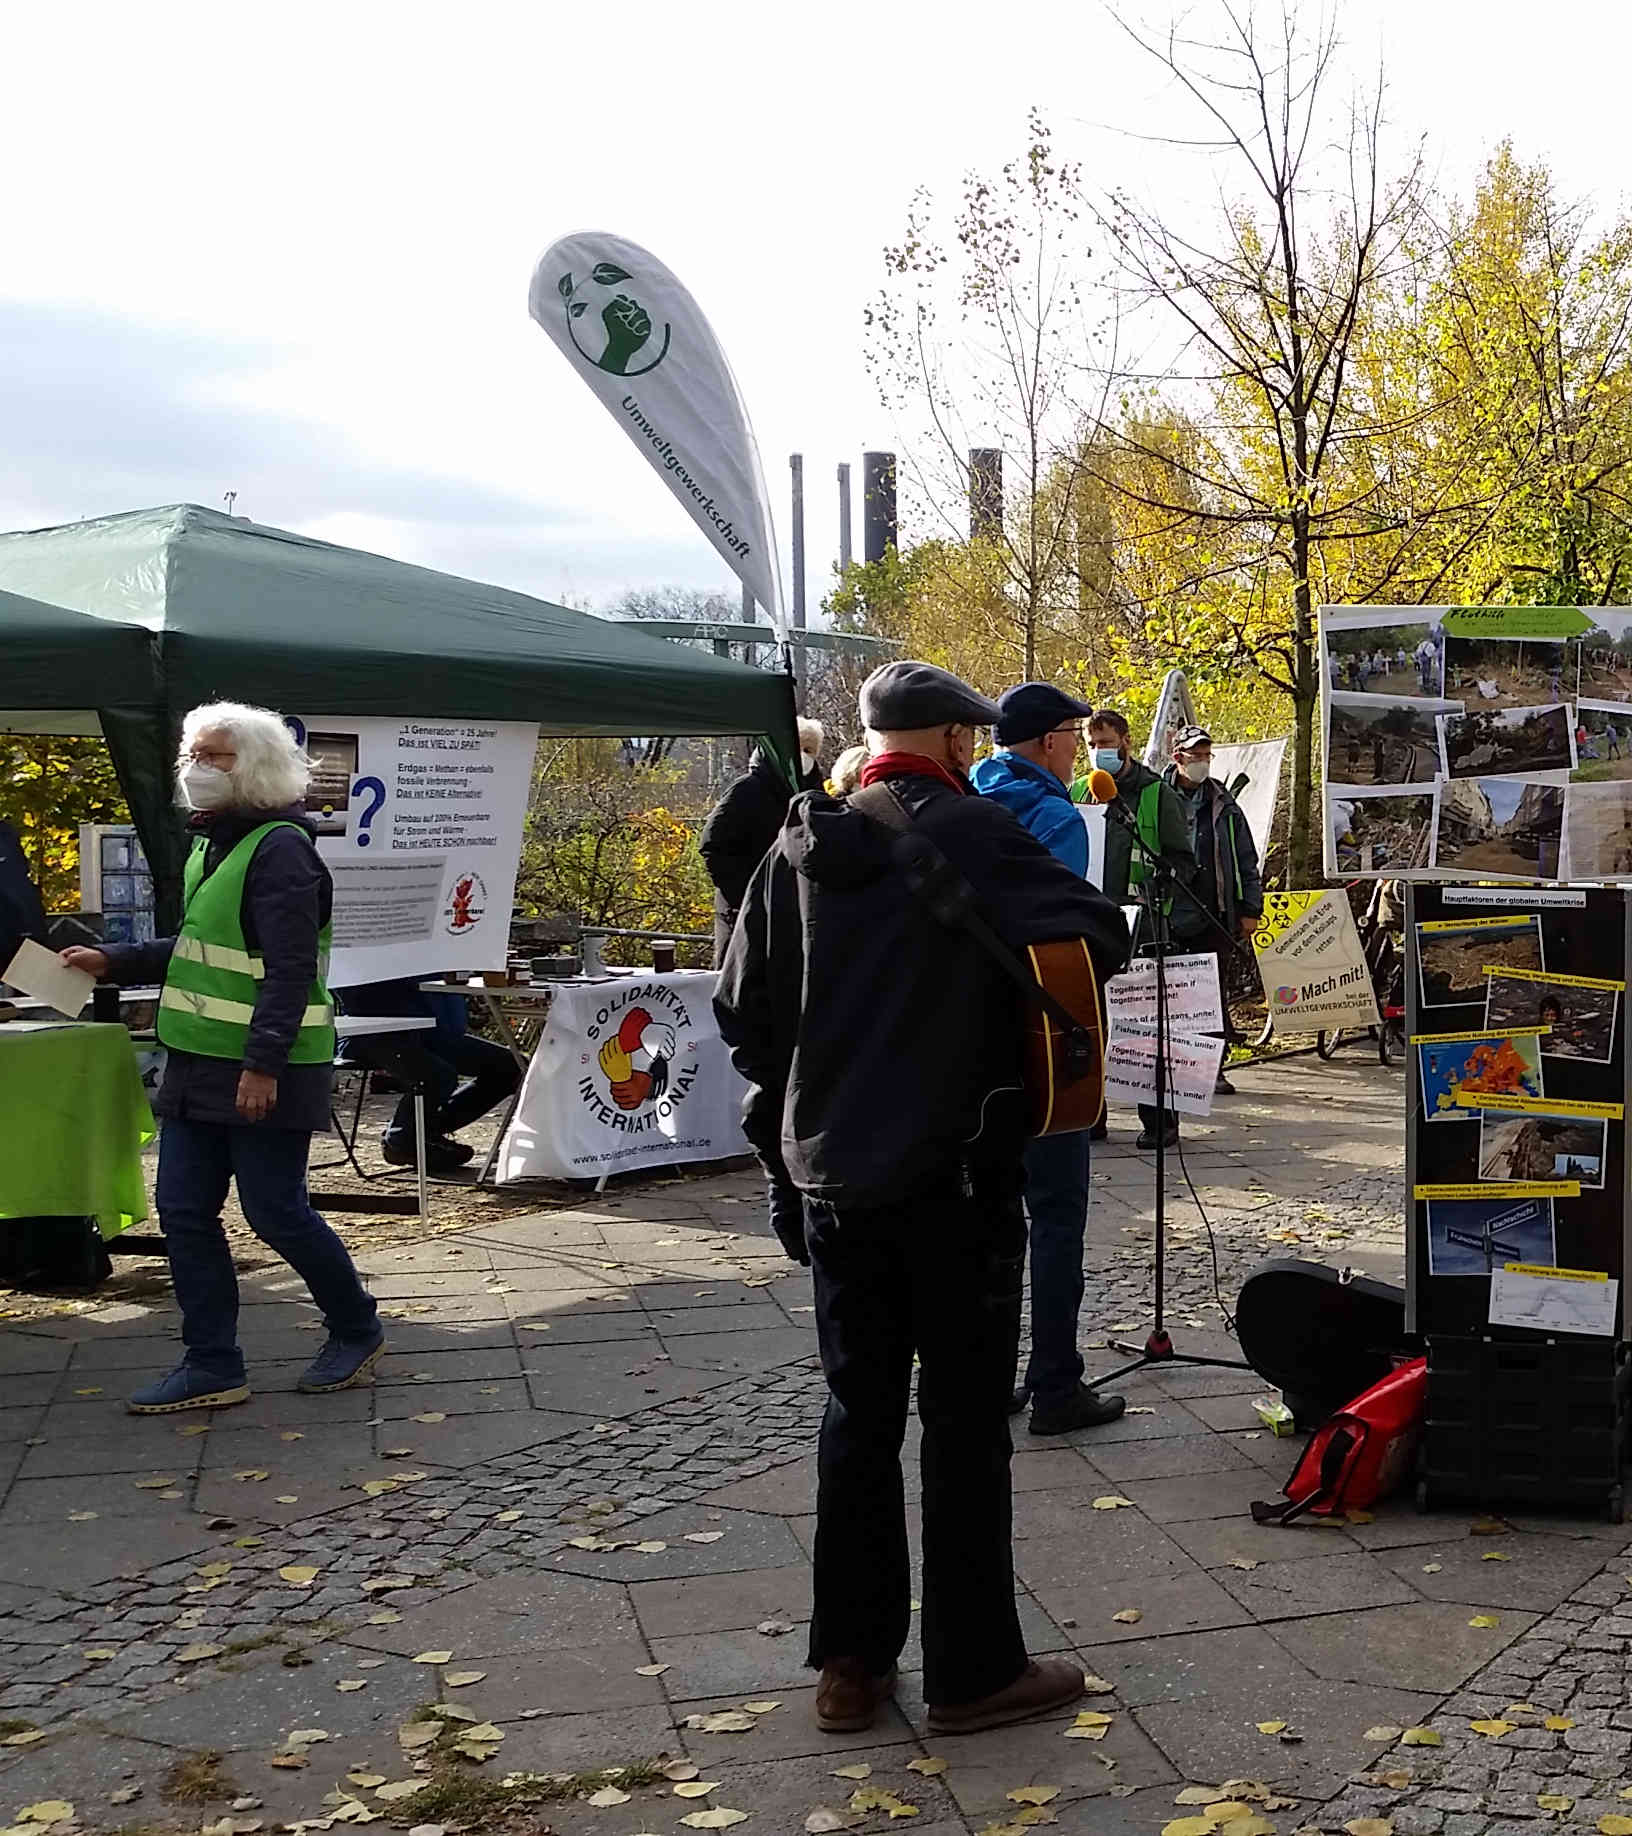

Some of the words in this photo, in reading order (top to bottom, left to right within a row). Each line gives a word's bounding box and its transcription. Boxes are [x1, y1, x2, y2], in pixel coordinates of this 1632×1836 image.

[622, 395, 751, 559] Umweltgewerkschaft
[398, 738, 415, 749] Das
[416, 740, 429, 750] ist
[431, 739, 447, 750] VIEL
[449, 740, 459, 750] ZU
[398, 763, 427, 775] Erdgas
[397, 776, 424, 785] fossile
[396, 788, 412, 798] Das
[414, 790, 424, 799] ist
[394, 814, 421, 823] Umbau
[407, 827, 427, 836] Strom
[392, 838, 408, 849] Das
[1444, 895, 1494, 903] Hauptfaktoren
[1496, 896, 1507, 904] der
[1509, 897, 1539, 905] globalen
[1541, 898, 1585, 906] Umweltkrise
[1135, 964, 1144, 972] of
[1302, 975, 1337, 1002] Mach
[1339, 964, 1365, 985] mit!
[1110, 985, 1144, 995] Together
[1110, 996, 1144, 1005] together
[586, 983, 693, 1041] SOLIDARITÄT
[1275, 999, 1373, 1016] UMWELTGEWERKSCHAFT
[1115, 1024, 1140, 1036] Fishes
[1142, 1030, 1151, 1038] of
[1194, 1040, 1217, 1050] unite!
[1112, 1045, 1144, 1057] Together
[1109, 1056, 1140, 1067] together
[1104, 1075, 1129, 1086] Fishes
[1183, 1091, 1206, 1101] unite!
[579, 1063, 699, 1134] INTERNATIONAL
